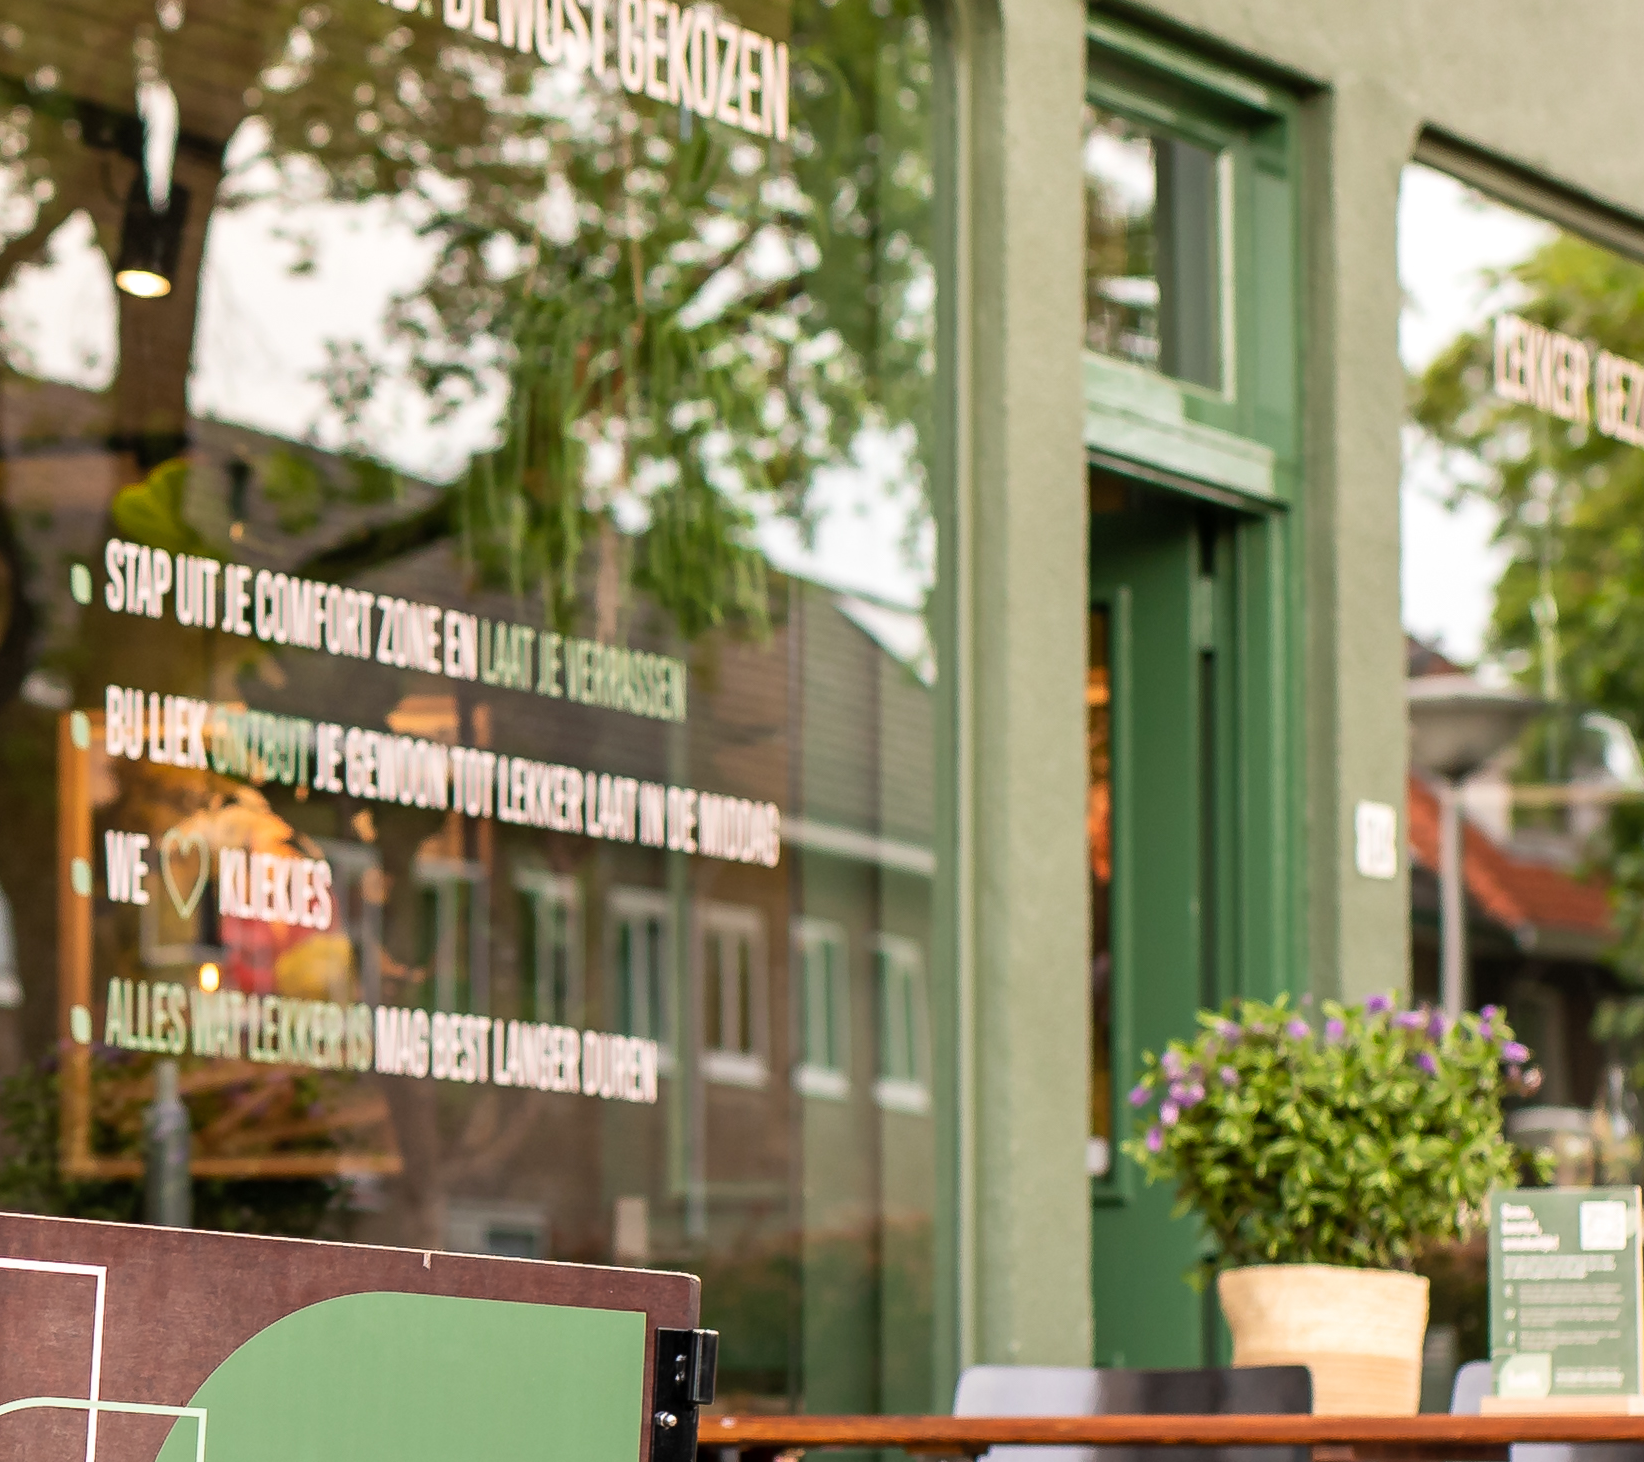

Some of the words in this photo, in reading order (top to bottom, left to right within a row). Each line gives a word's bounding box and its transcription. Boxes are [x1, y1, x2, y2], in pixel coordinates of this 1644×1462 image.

[104, 537, 173, 620] STAP
[175, 551, 221, 629] UIT
[221, 562, 253, 637] JE
[255, 568, 376, 661] COMFORT
[375, 594, 442, 675] ZONE
[443, 608, 478, 683] EN
[148, 691, 209, 770] LIEK
[313, 721, 344, 795] JE
[345, 726, 449, 811] GEWOON
[497, 753, 583, 835] LEKKER
[584, 770, 639, 843] LAAT
[105, 829, 150, 906] WE
[104, 976, 188, 1056] ALLES
[374, 1004, 429, 1079] MAG
[431, 1011, 492, 1084] BEST
